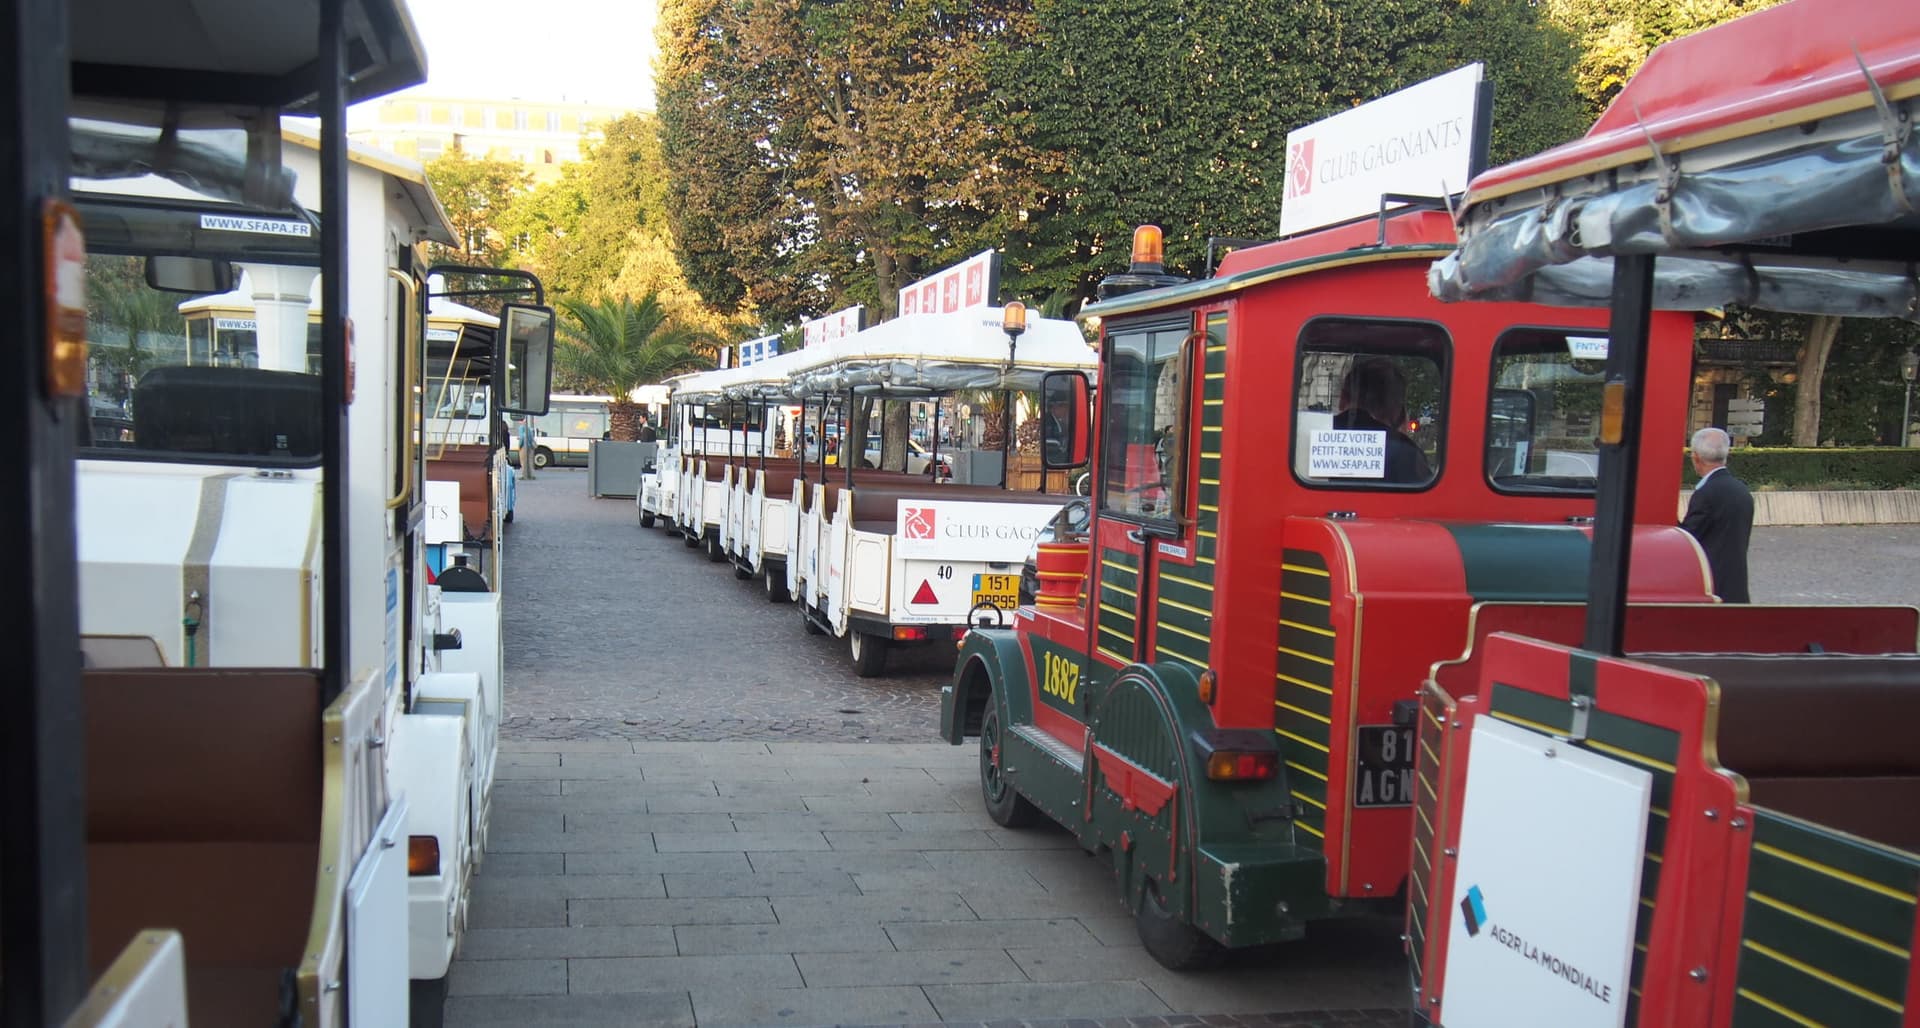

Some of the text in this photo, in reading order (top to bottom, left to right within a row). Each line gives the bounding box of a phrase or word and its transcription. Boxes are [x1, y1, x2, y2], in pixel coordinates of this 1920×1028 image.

[1319, 116, 1464, 185] CLUB GAGNANTS
[203, 216, 310, 235] WWW.SFAPA.FR
[218, 319, 257, 329] WWW.SFA
[1318, 432, 1377, 444] LOUEZ VOTRE
[1311, 445, 1384, 457] PETIT-TRAIN SUR
[1312, 459, 1382, 470] WWW.SFAPA.FR
[426, 504, 449, 520] TS
[944, 523, 1043, 540] CLUB GAGN
[937, 565, 953, 580] 40
[988, 576, 1010, 591] 151
[1043, 650, 1080, 705] 1887
[1381, 729, 1415, 763] 81
[1359, 767, 1416, 803] AGN
[1490, 923, 1612, 1005] AG2R LA MONDIALE
